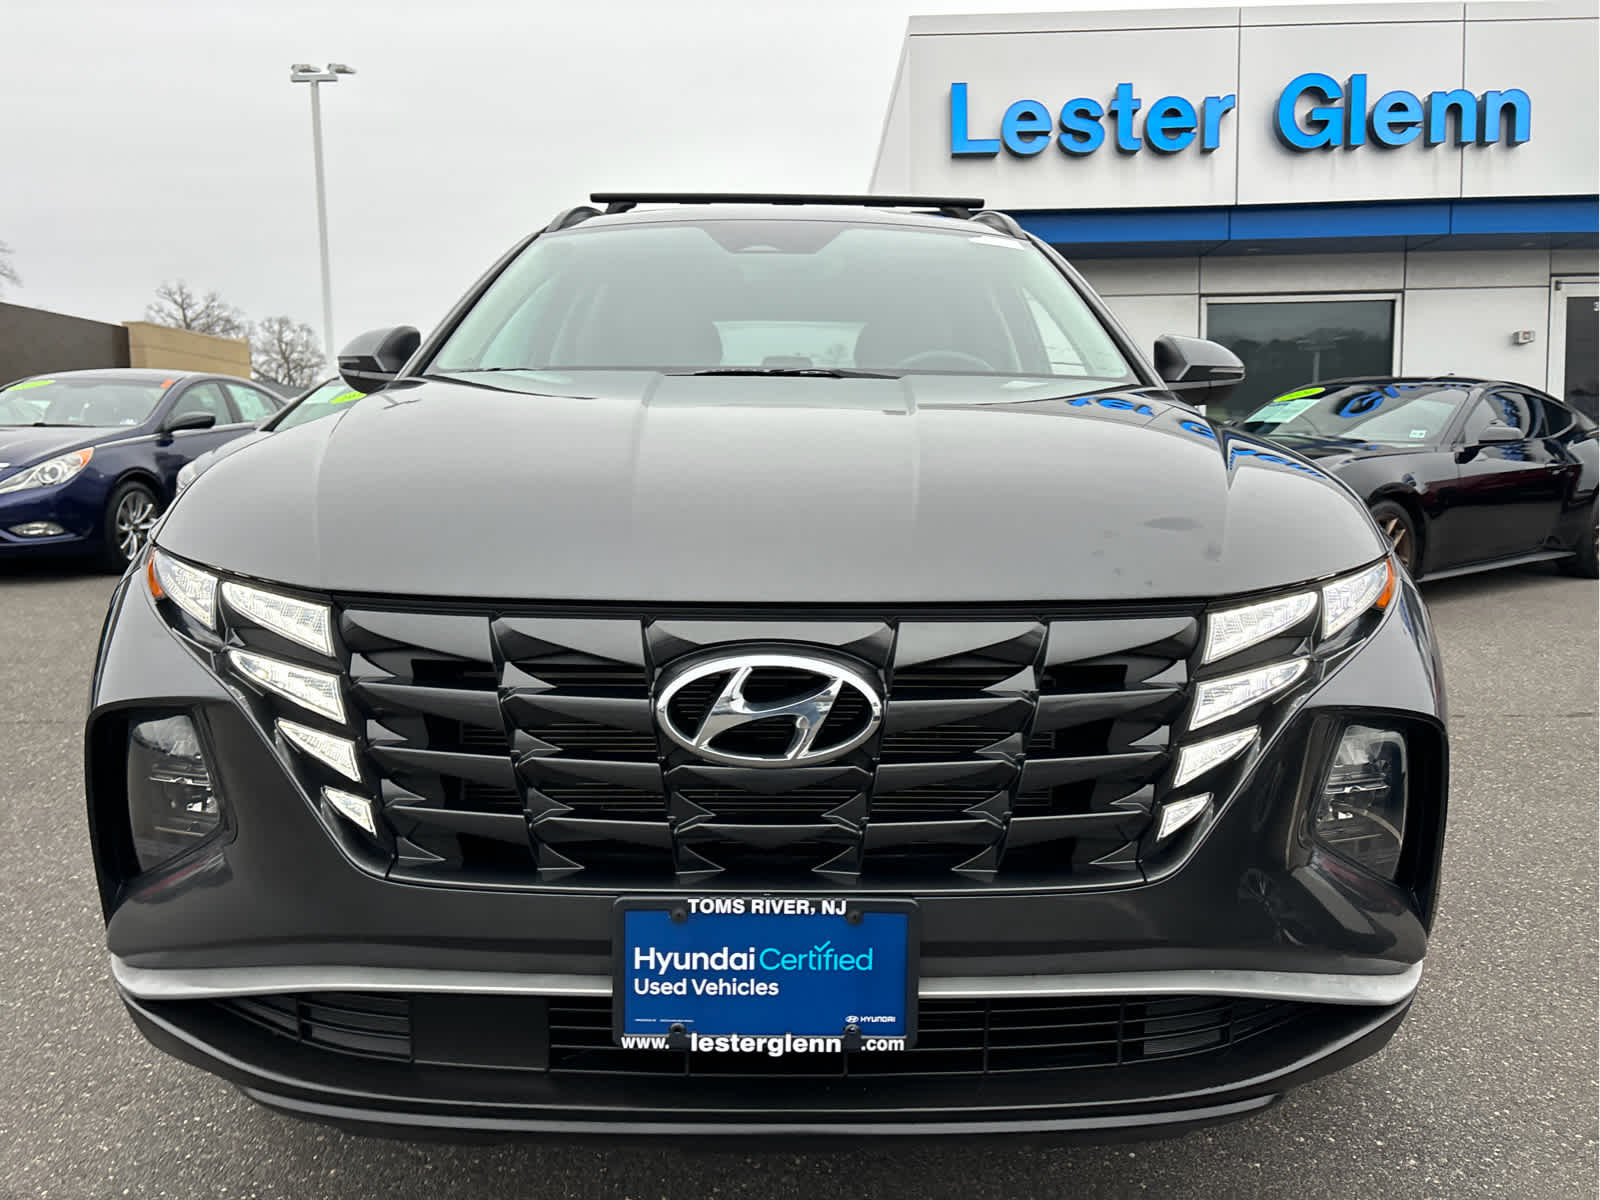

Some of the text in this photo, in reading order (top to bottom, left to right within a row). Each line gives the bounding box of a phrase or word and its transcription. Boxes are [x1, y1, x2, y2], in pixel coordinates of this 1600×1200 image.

[949, 72, 1532, 157] Lester Glenn
[687, 898, 848, 916] TOMS RIVER, NJ
[633, 940, 874, 975] Hyundai Certified
[633, 977, 780, 996] Used Vehicles
[860, 1015, 897, 1023] HYUNDAI
[620, 1032, 905, 1057] www. lesterglenn .com
